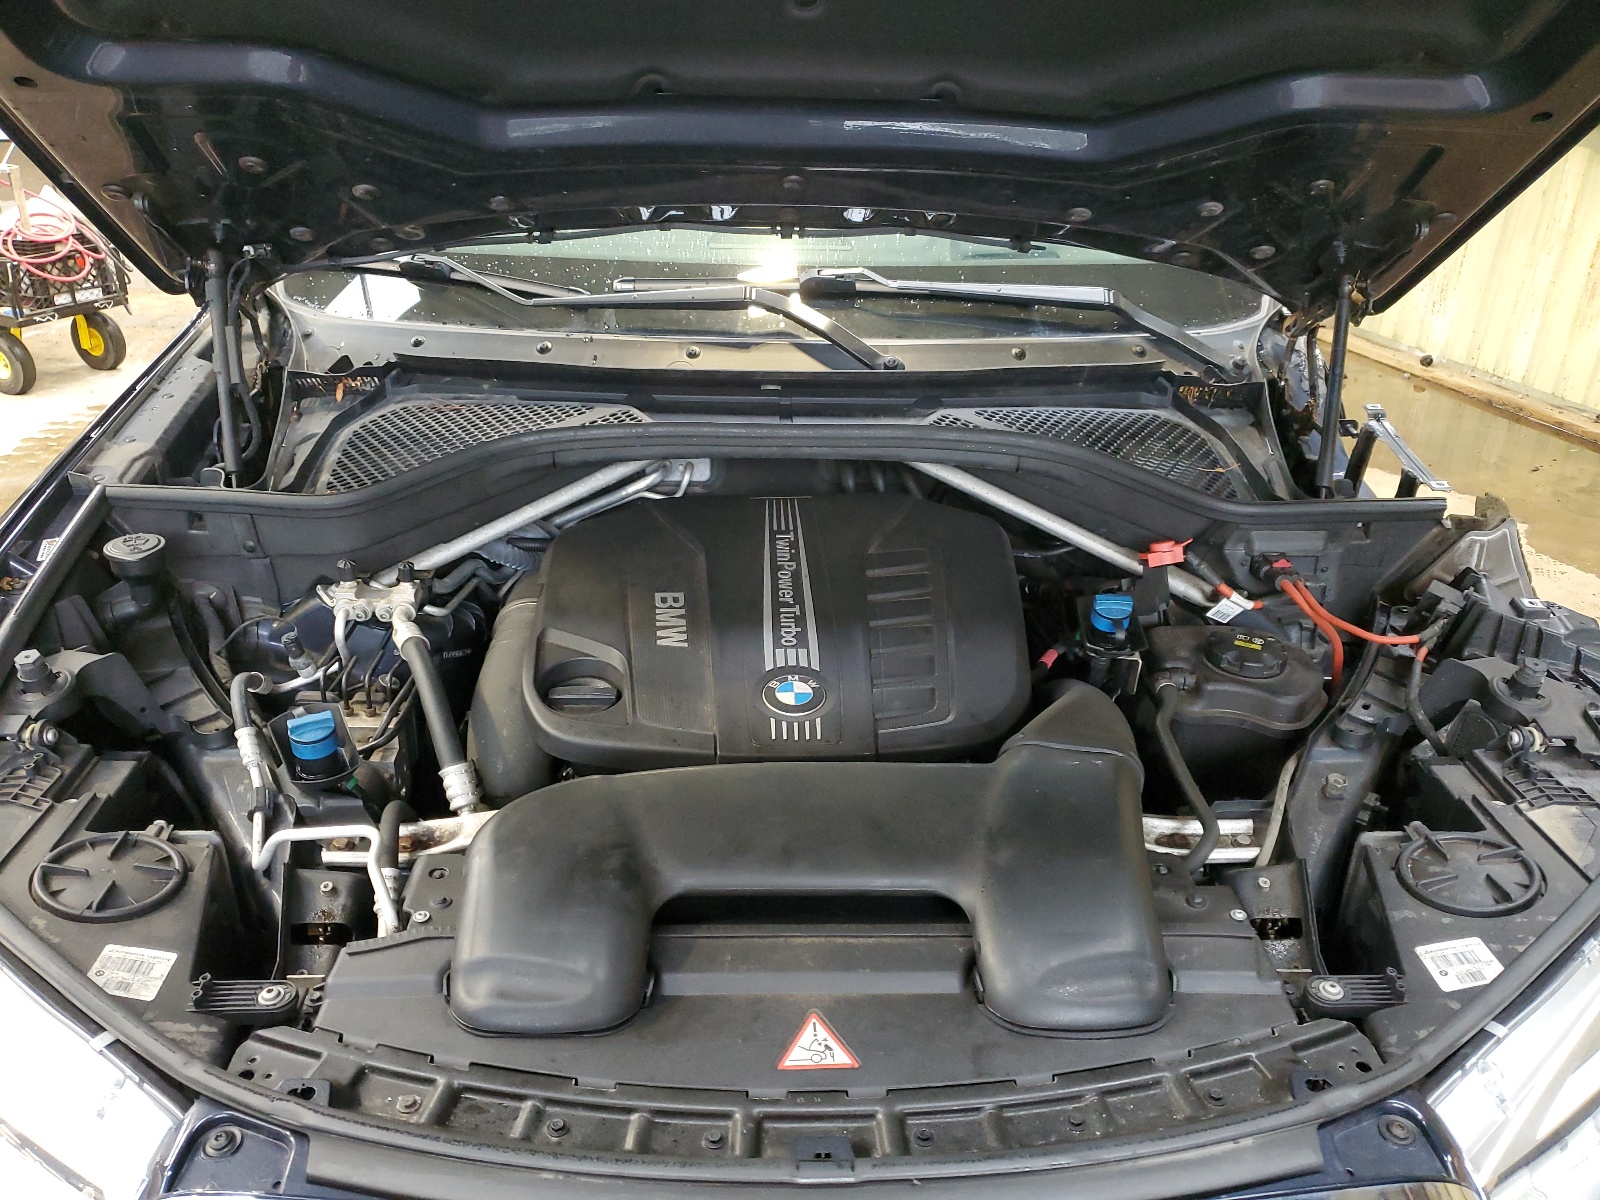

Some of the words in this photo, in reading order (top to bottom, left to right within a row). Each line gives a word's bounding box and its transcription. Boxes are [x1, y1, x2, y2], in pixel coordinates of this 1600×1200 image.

[775, 531, 797, 604] TwinPower
[655, 592, 688, 647] BMW
[779, 605, 801, 646] Turbo
[768, 675, 820, 688] BMW
